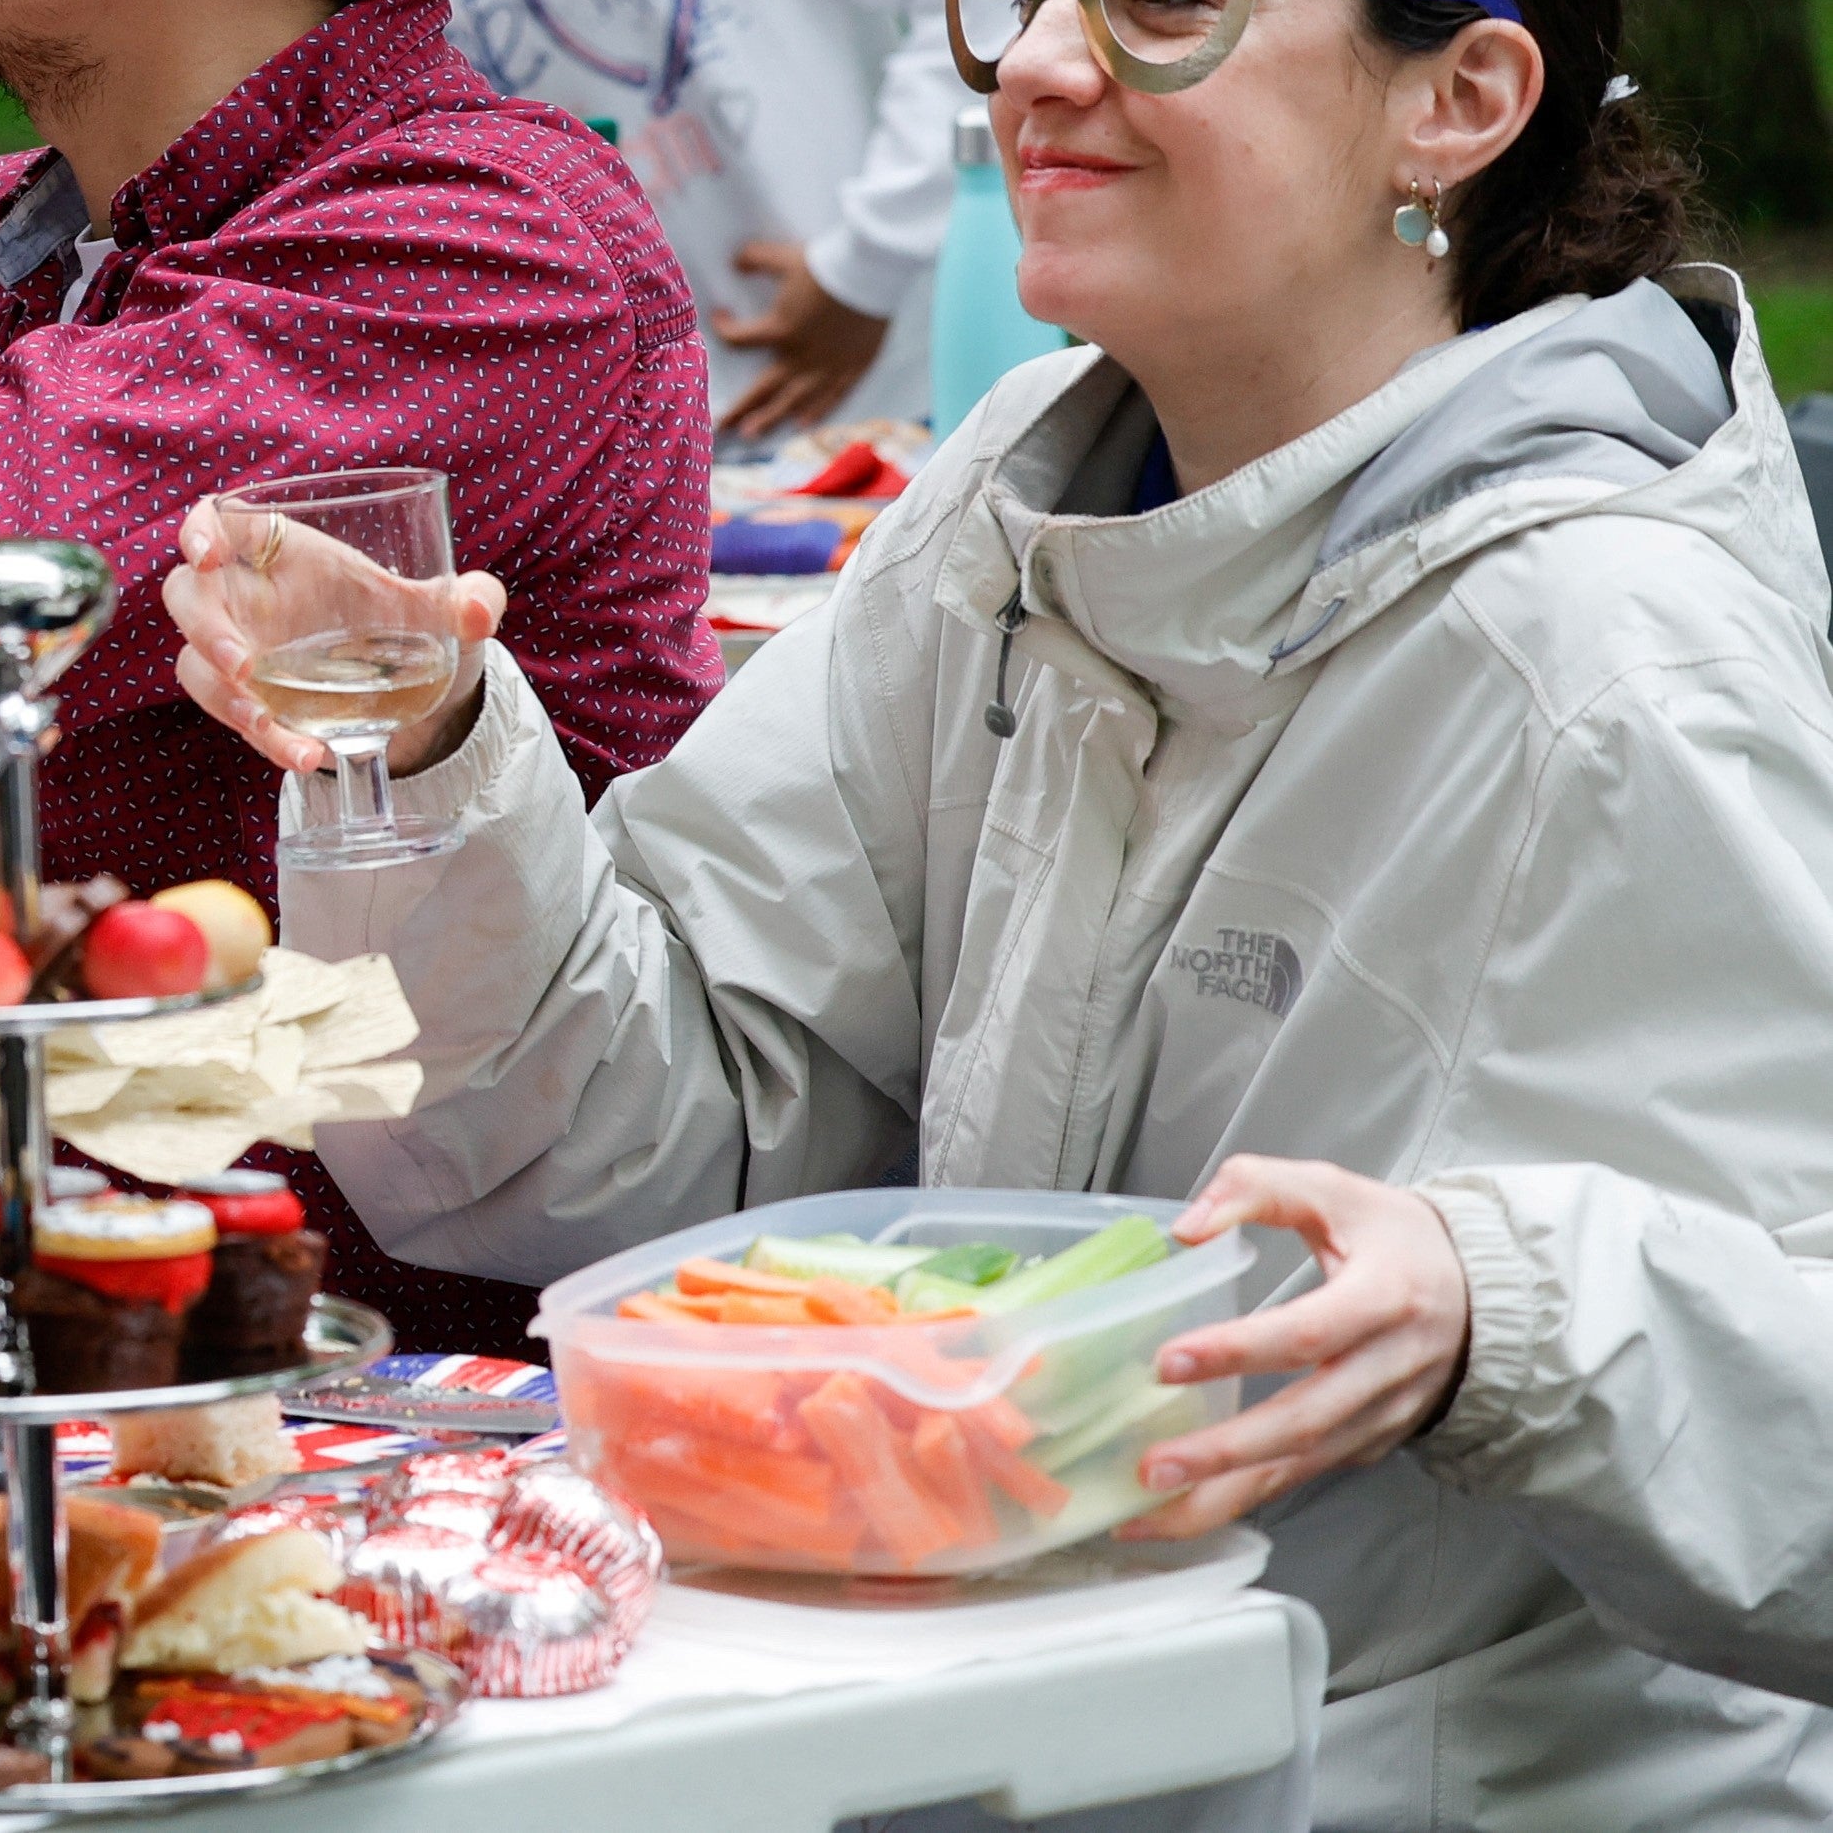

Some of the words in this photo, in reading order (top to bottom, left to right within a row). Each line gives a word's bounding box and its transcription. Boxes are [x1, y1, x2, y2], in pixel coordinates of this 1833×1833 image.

[1216, 928, 1274, 957] THE
[1170, 945, 1271, 982] NORTH
[1197, 974, 1270, 1006] FACE
